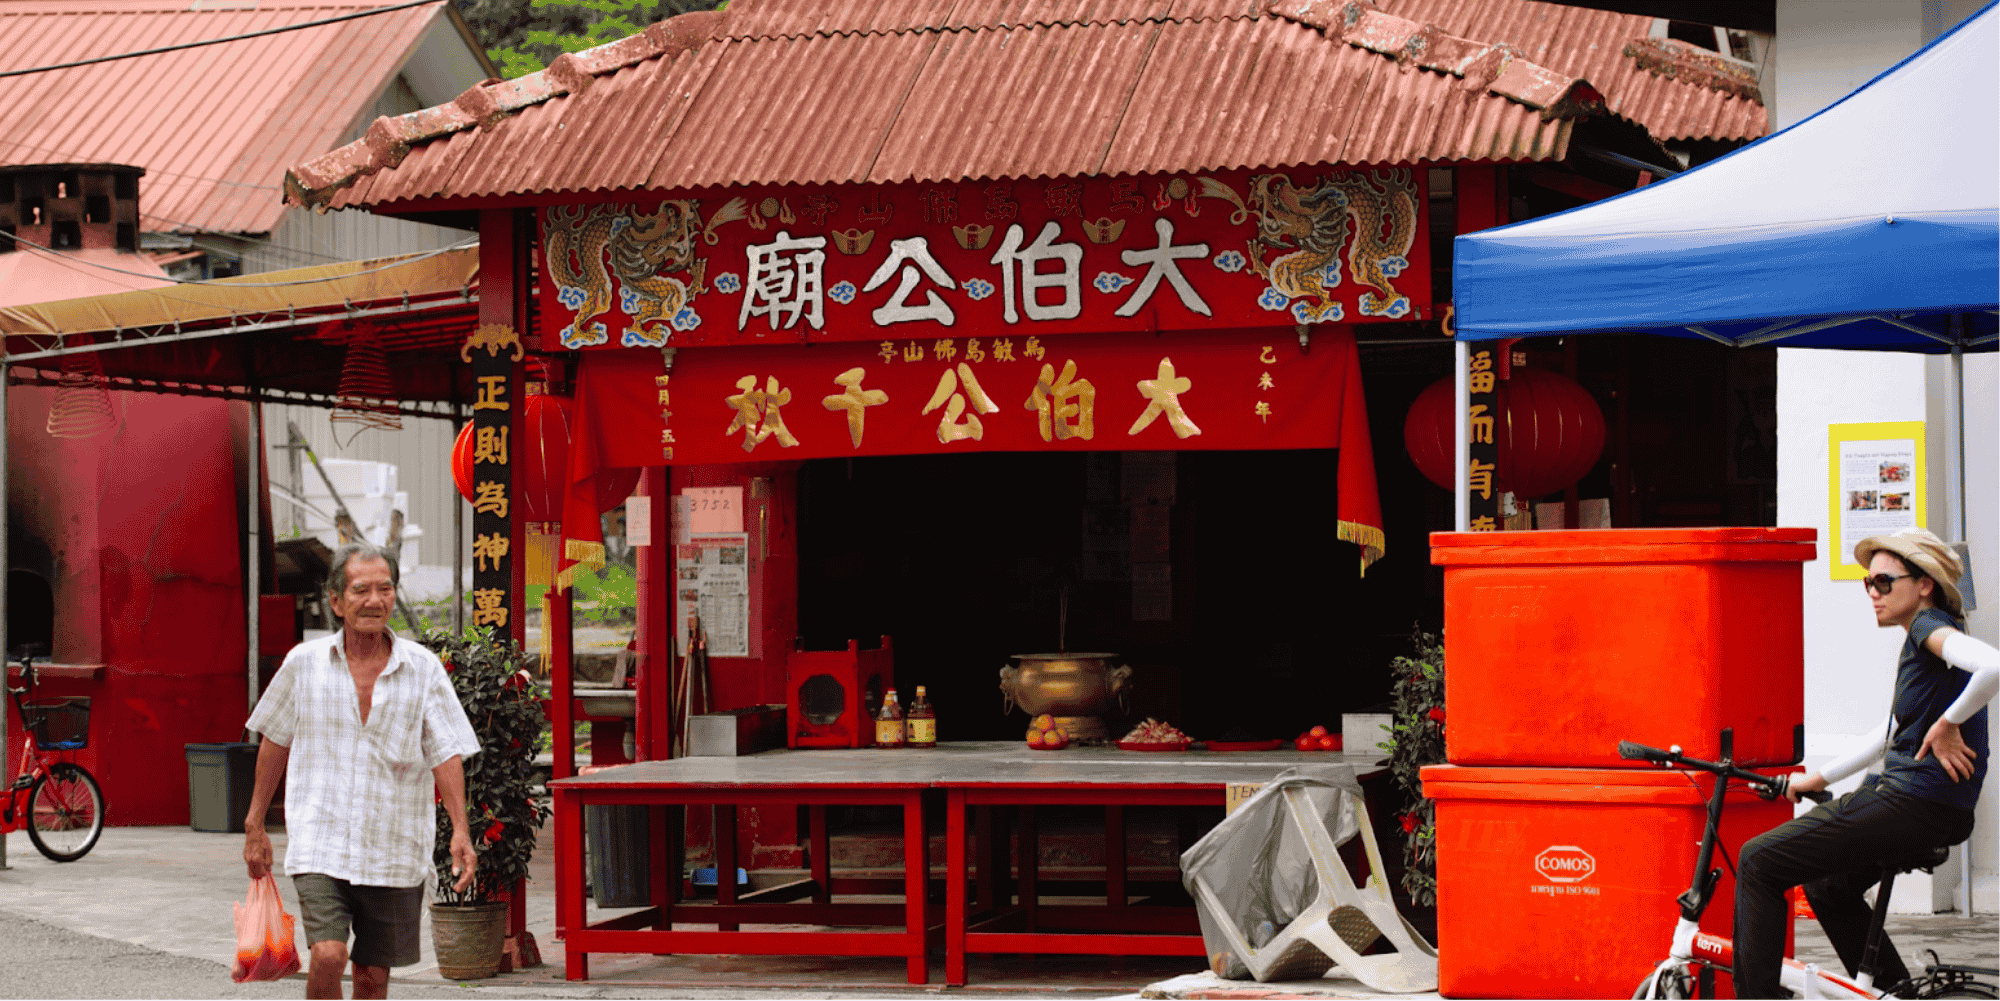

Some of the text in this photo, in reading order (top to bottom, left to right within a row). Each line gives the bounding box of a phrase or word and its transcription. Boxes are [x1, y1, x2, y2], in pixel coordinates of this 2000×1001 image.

[738, 217, 1213, 331] 大伯公廟
[655, 374, 676, 460] 四月十五日
[725, 357, 1202, 453] 大伯公千秋
[1254, 345, 1277, 424] 乙未年
[1540, 857, 1590, 871] COMOS
[1566, 885, 1581, 895] ISO
[1697, 937, 1722, 955] tern
